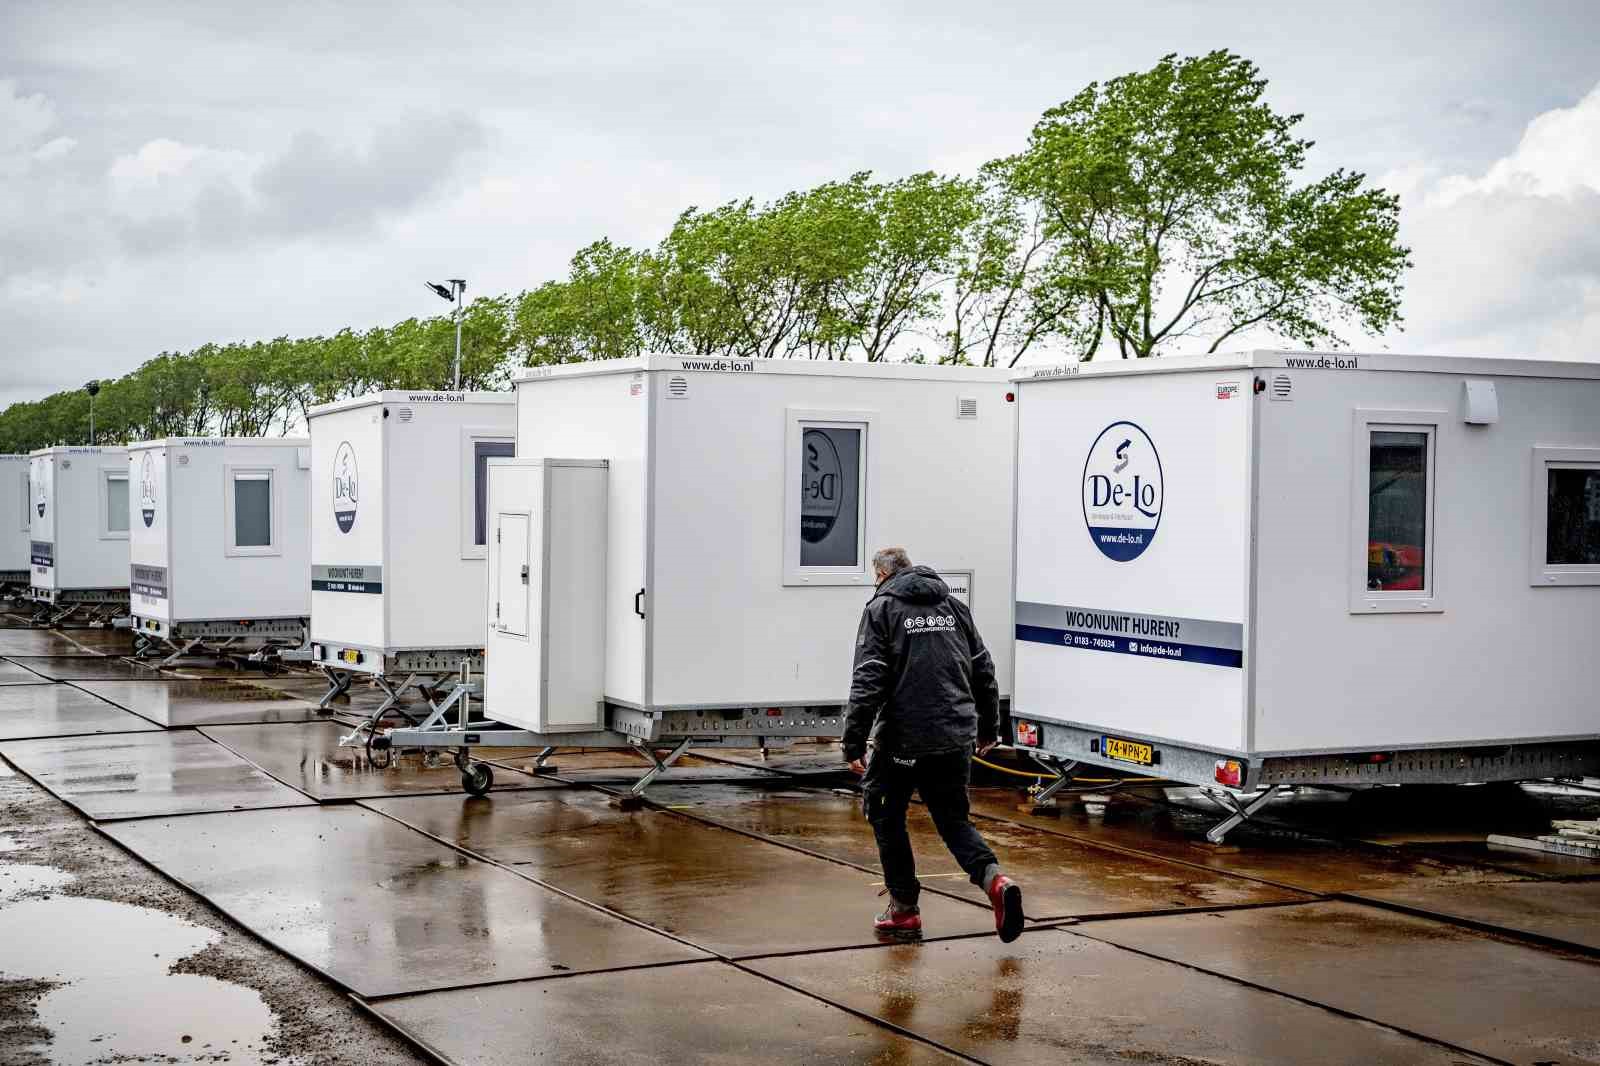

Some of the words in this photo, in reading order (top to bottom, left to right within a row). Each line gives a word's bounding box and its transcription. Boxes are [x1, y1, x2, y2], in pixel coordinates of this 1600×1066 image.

[682, 360, 753, 372] www.de-lo.nl
[1285, 355, 1358, 369] www.de-lo.nl
[408, 393, 465, 402] www.de-lo.nl
[1100, 531, 1143, 544] www.de-lo.nl
[1066, 610, 1130, 633] WOONUNIT
[1132, 619, 1180, 638] HUREN?
